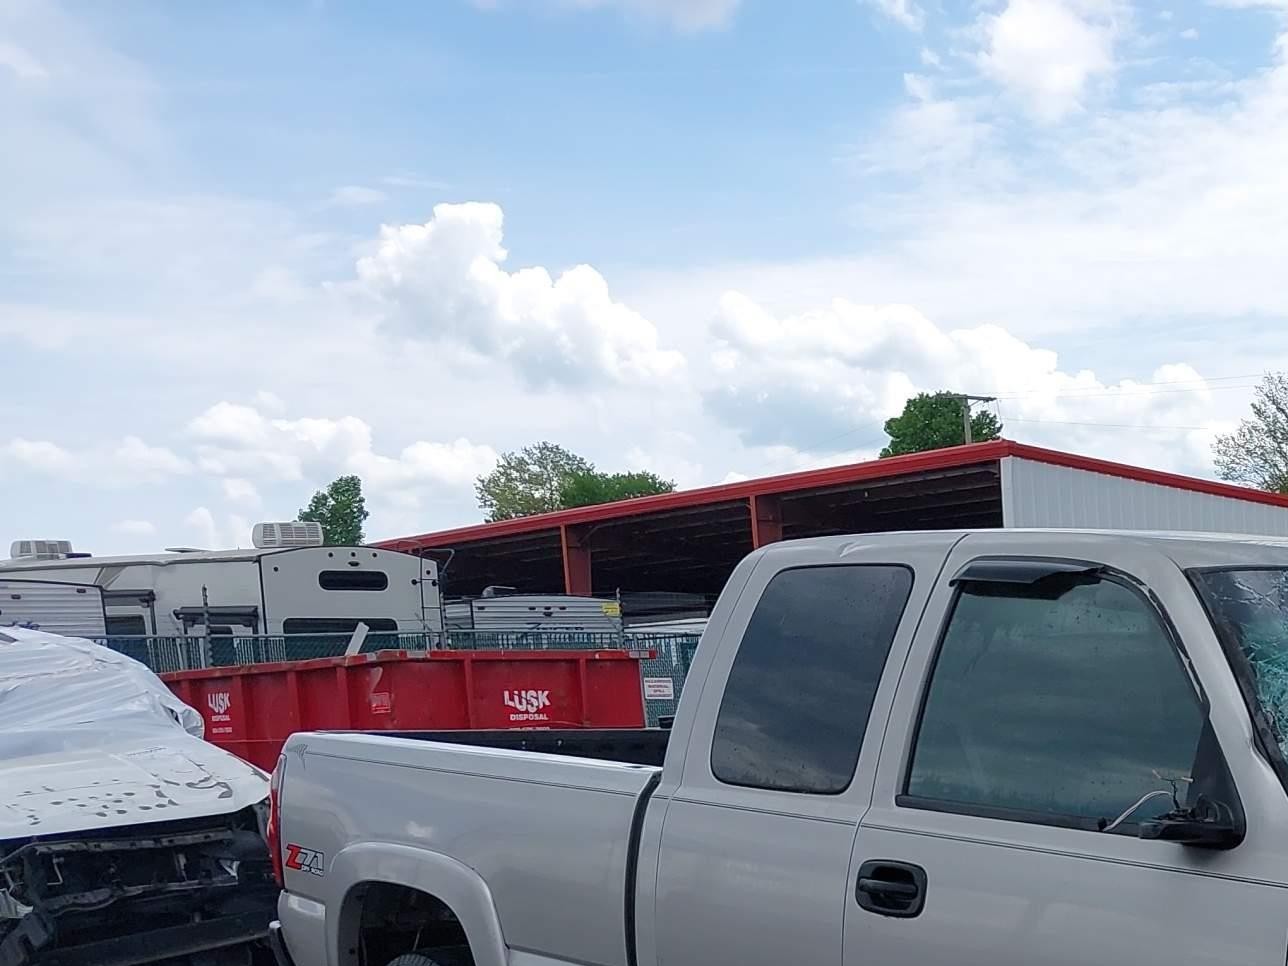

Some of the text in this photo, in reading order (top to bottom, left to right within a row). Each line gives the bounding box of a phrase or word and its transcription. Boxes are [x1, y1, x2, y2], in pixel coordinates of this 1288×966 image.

[207, 692, 231, 714] LUSK
[503, 690, 551, 713] LUSK
[509, 713, 549, 721] DISPOSAL
[286, 843, 325, 871] Z71
